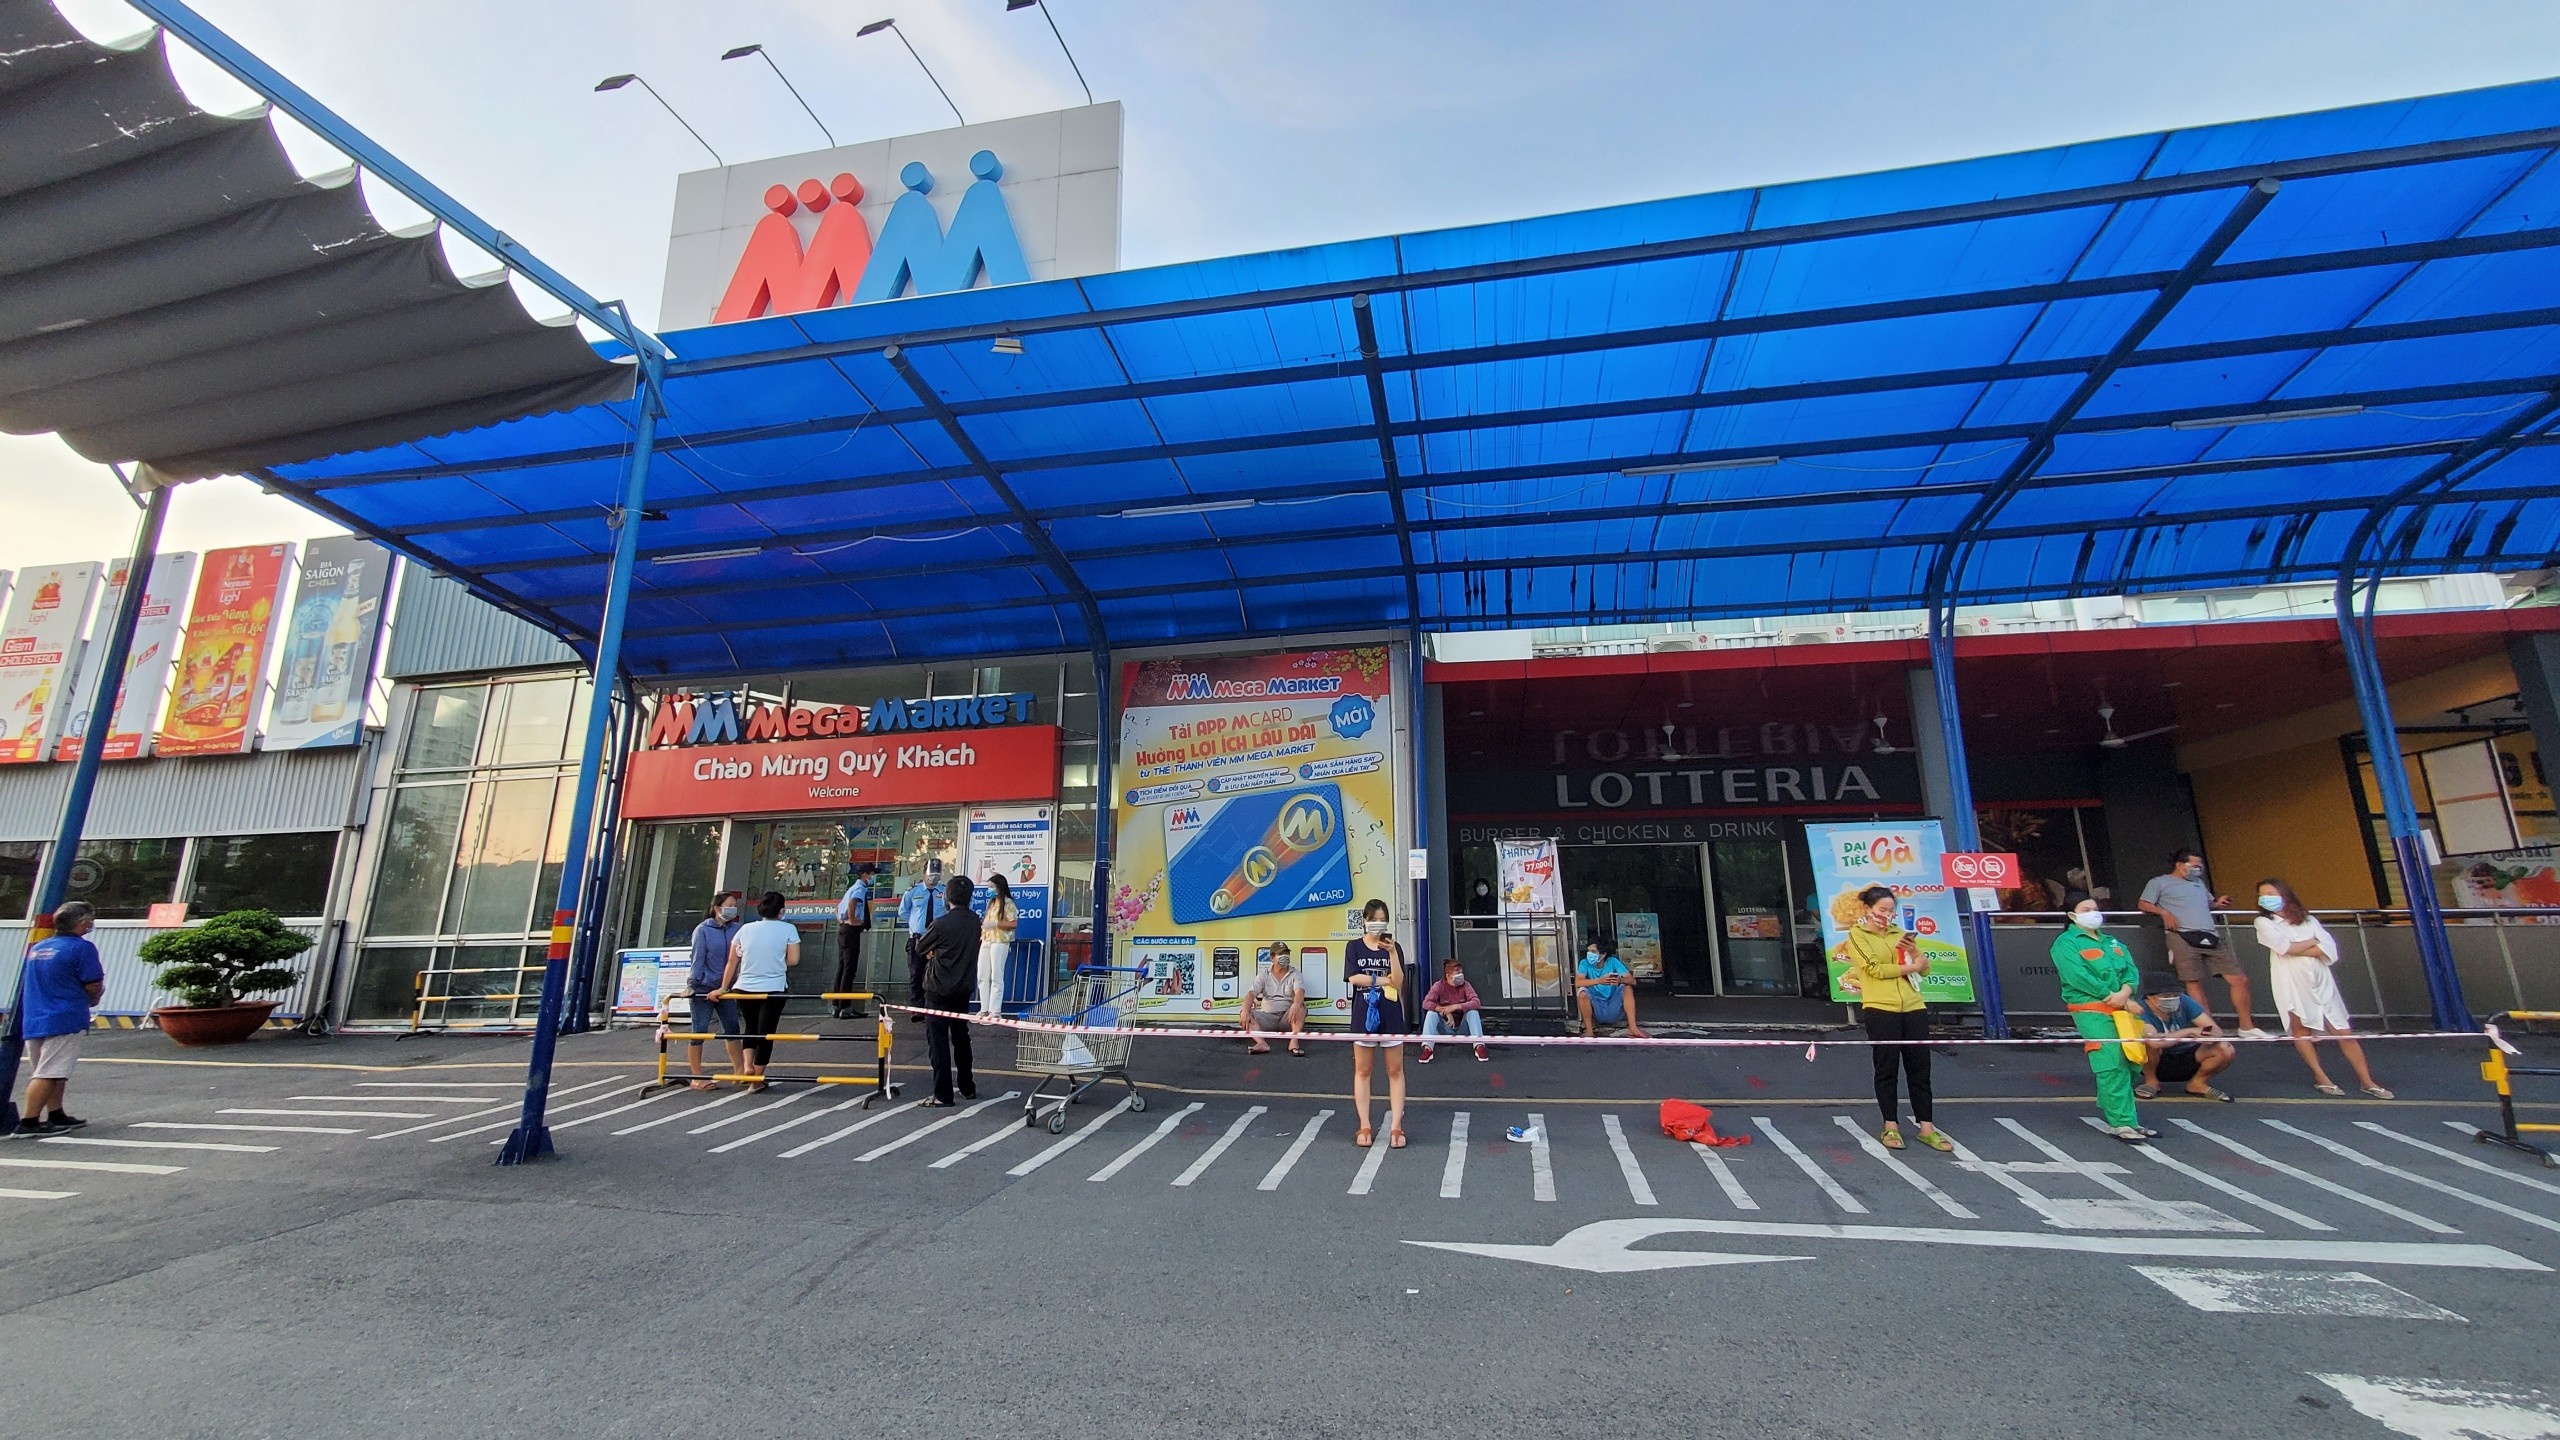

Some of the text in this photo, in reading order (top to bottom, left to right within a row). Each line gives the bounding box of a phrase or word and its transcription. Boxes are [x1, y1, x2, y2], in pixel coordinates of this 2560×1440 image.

[320, 561, 333, 569] BIA
[305, 566, 344, 580] SAIGON
[308, 578, 337, 588] CHILL
[1168, 706, 1293, 740] Tải APP MCARD
[1334, 706, 1369, 728] MỚI
[1136, 721, 1317, 766] Hưởng LỢI ÍCH LÂU DÀI
[694, 742, 976, 781] Chào Mừng Quý Khách
[1140, 743, 1316, 778] từ THẺ THÀNH VIÊN MM MEGA MARKET
[808, 785, 860, 799] Welcome
[1555, 765, 1881, 808] LOTTERIA
[1460, 821, 1776, 842] BURGER & CHICKEN & DRINK
[1843, 841, 1867, 854] ĐẠI
[1841, 854, 1869, 867] TIỆC
[1022, 889, 1041, 900] Ngày
[1308, 889, 1345, 903] MCARD
[1737, 906, 1767, 914] LOTTERIA
[1136, 937, 1150, 945] CÁC
[1150, 937, 1168, 945] BƯỚC
[1181, 937, 1194, 946] ĐẶT
[1367, 958, 1381, 967] TUK
[1382, 958, 1390, 967] TU
